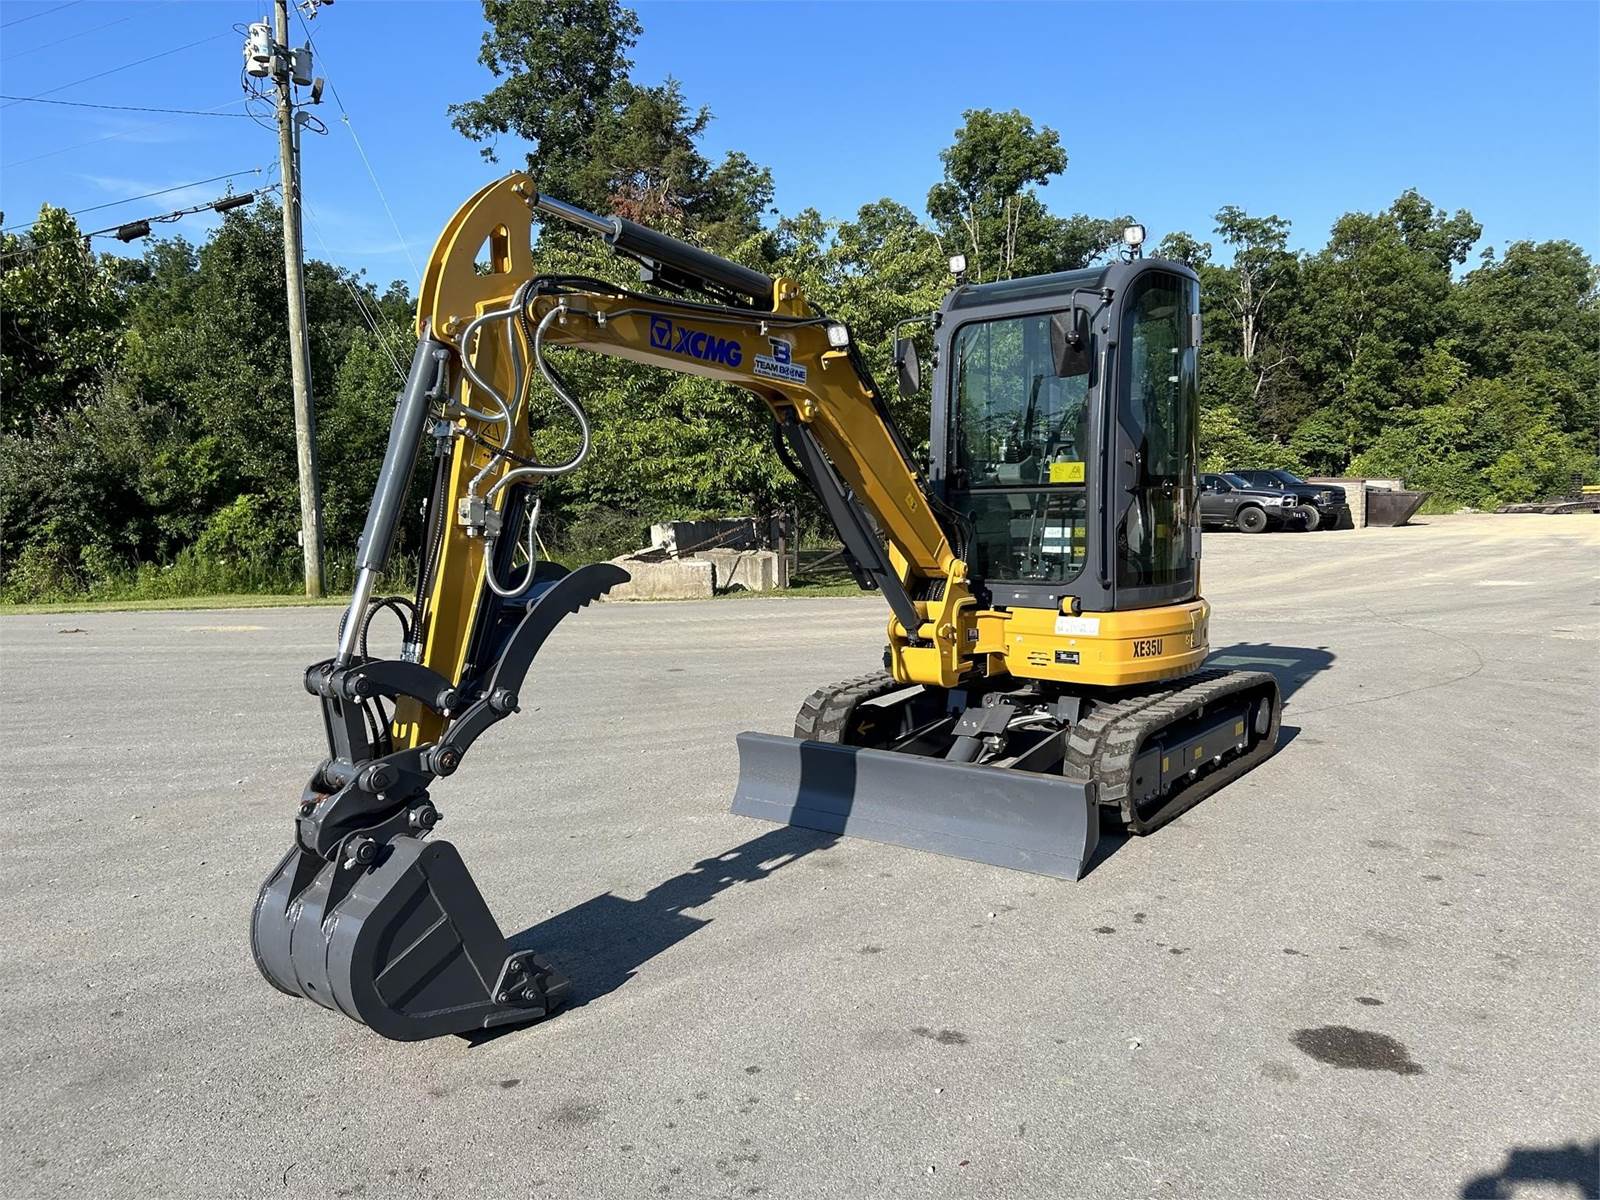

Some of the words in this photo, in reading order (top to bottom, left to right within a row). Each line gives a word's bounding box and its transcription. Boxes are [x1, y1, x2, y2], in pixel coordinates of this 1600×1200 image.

[671, 327, 742, 367] XCMG
[755, 359, 779, 373] TEAM
[1133, 638, 1163, 658] XE35U
